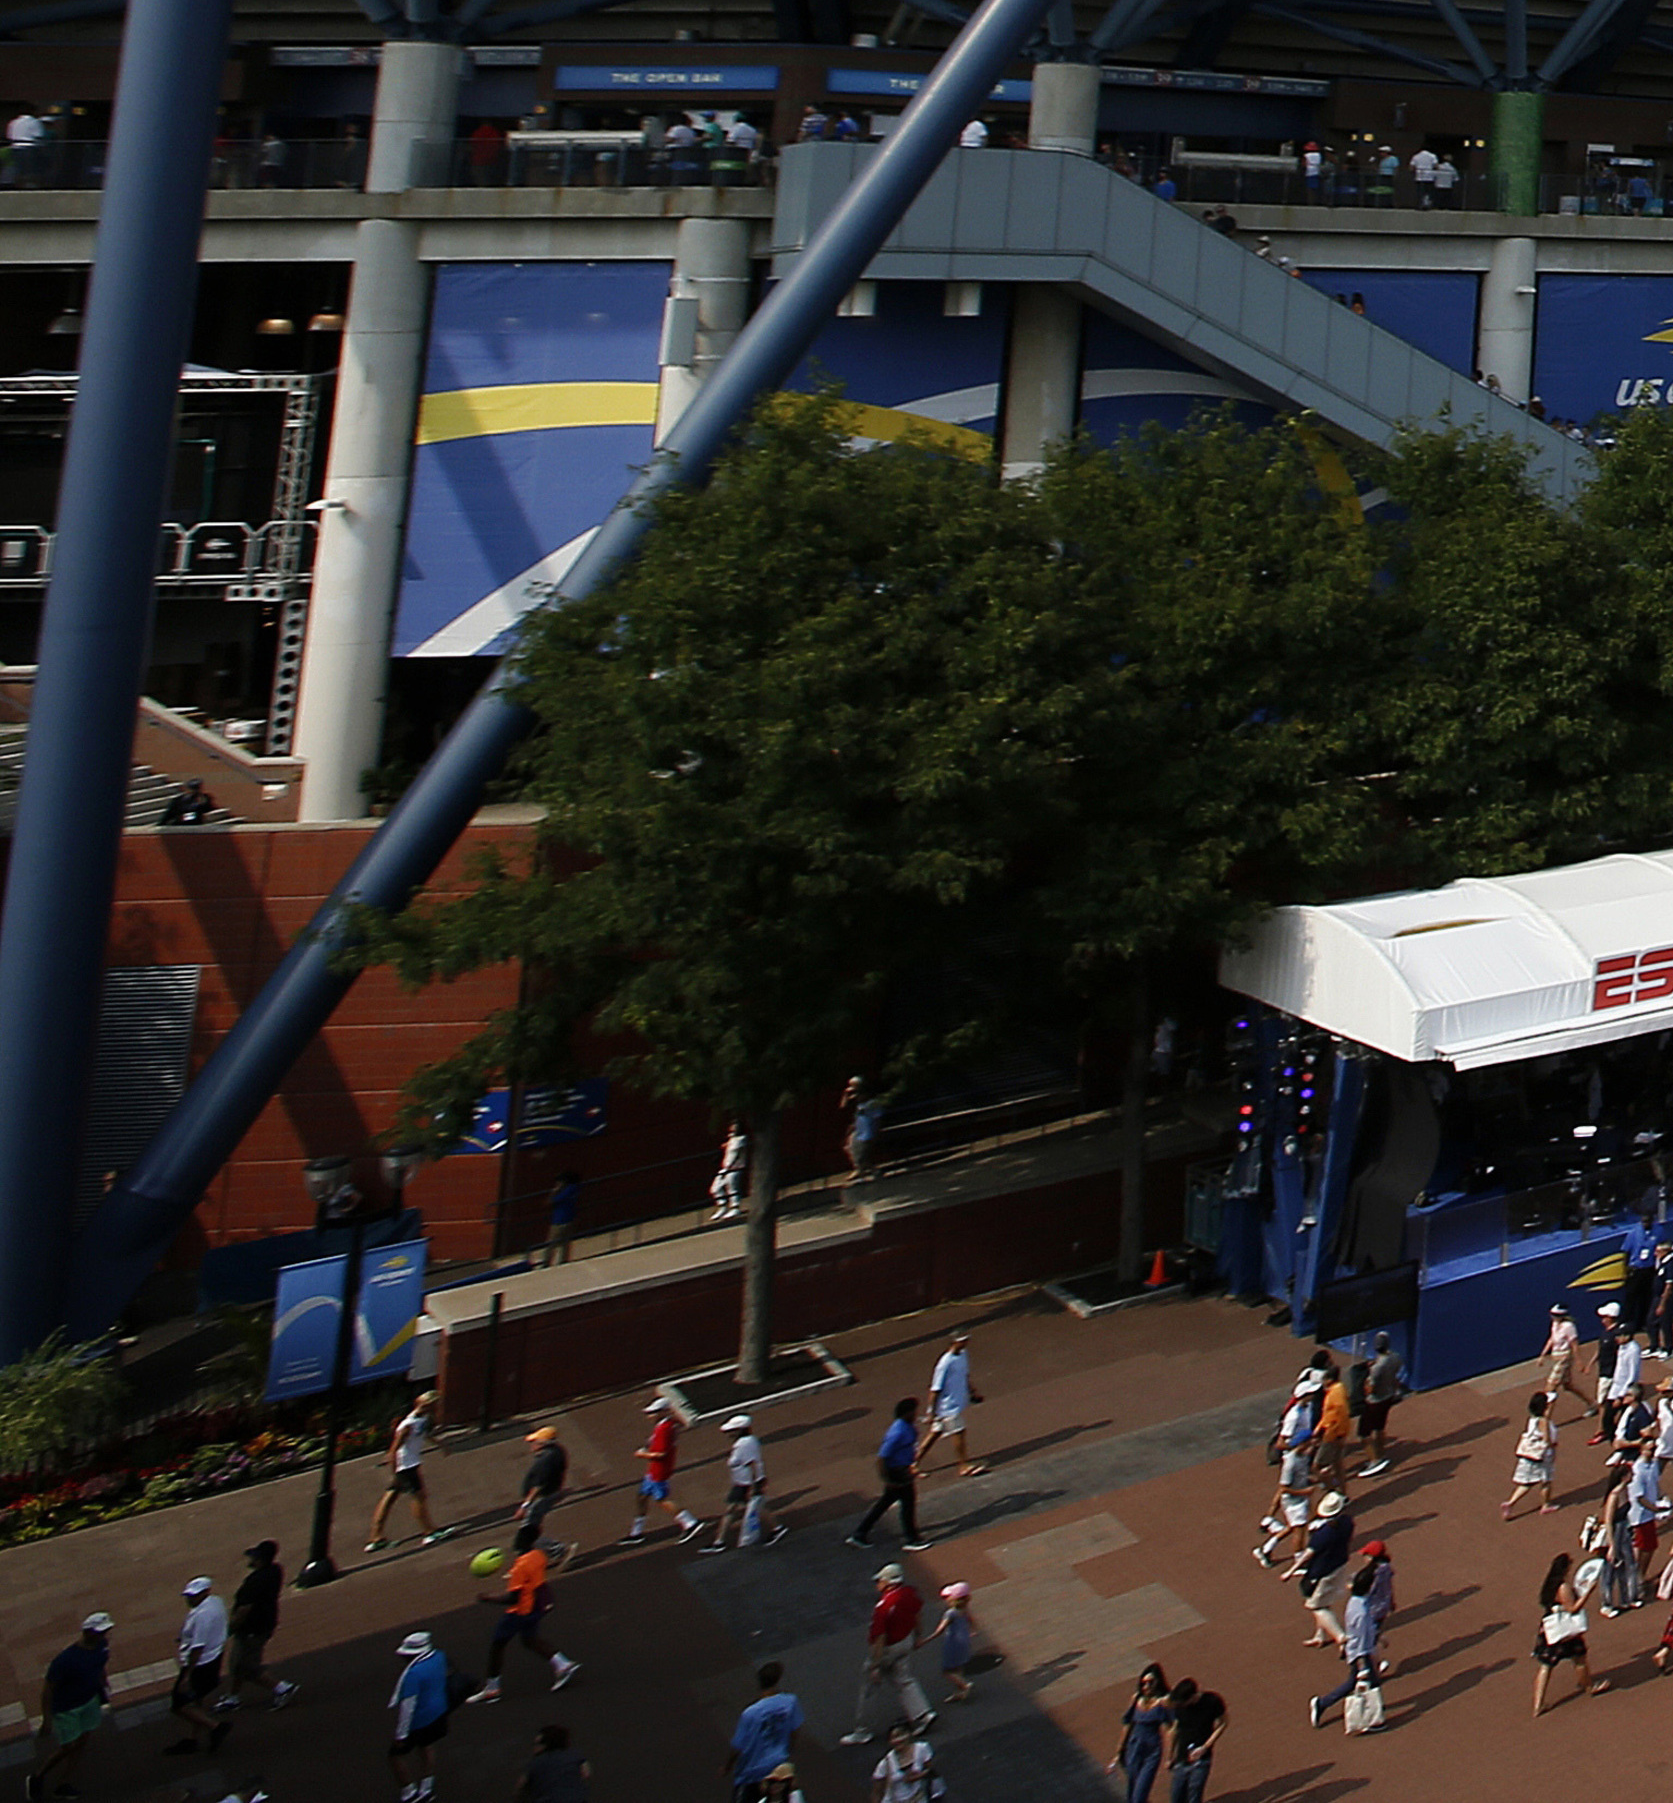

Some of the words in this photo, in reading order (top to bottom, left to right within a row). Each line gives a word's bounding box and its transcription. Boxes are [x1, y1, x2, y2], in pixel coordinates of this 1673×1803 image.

[611, 73, 640, 83] THE
[645, 73, 685, 83] OPEN
[692, 73, 722, 83] BAR
